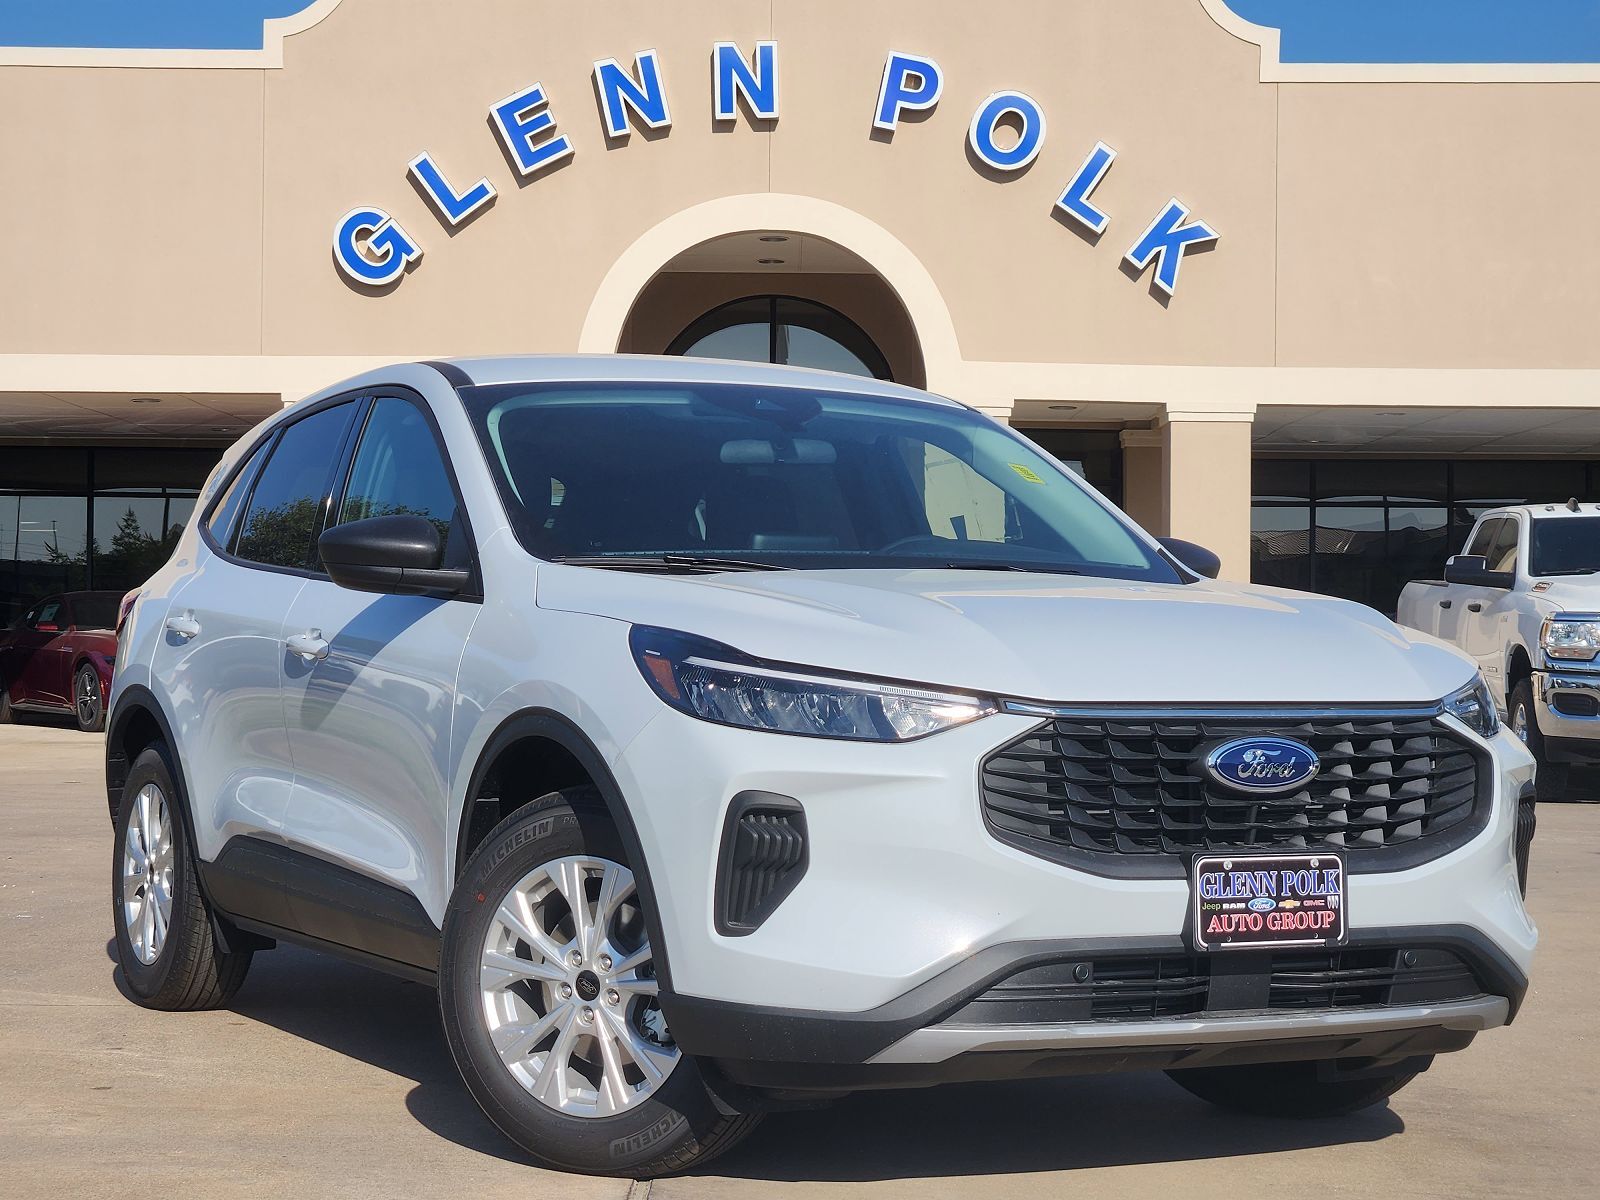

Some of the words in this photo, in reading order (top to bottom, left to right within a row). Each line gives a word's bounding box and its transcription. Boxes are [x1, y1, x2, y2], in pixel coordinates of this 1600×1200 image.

[332, 40, 779, 286] GLENN
[872, 50, 1221, 298] POLK
[1237, 749, 1296, 778] Ford
[482, 820, 550, 877] MICHELIN
[1200, 871, 1277, 899] GLENN
[1281, 869, 1340, 896] POLK
[1202, 902, 1221, 911] Jeep
[1223, 902, 1246, 910] RAM
[1303, 899, 1325, 907] GMC
[1207, 913, 1263, 933] AUTO
[1266, 911, 1336, 931] GROUP
